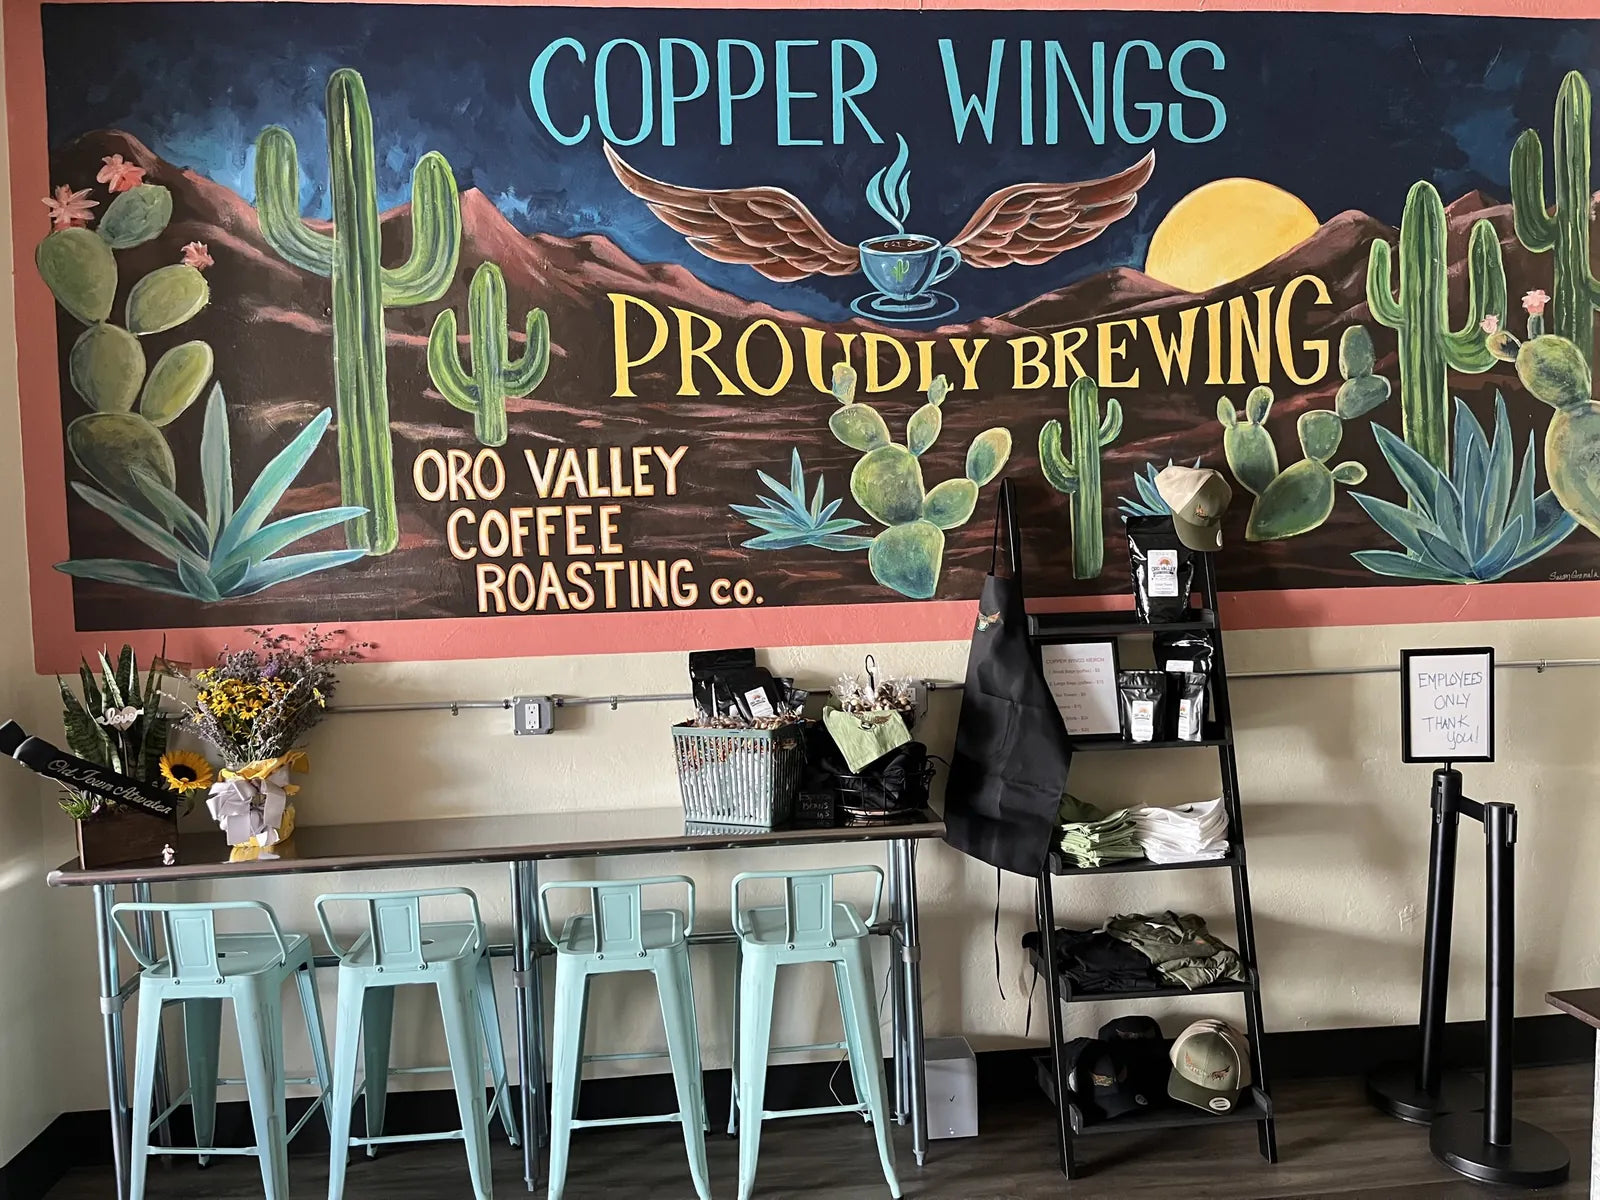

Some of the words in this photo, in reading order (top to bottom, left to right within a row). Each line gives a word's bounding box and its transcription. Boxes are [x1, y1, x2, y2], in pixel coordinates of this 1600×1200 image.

[529, 37, 883, 147] COPPER
[938, 38, 1227, 145] WINGS
[607, 293, 989, 397] PROUDLY
[1006, 274, 1333, 389] BREWING
[413, 448, 506, 502] ORO
[524, 445, 689, 498] VALLEY
[447, 505, 624, 560] COFFEE
[476, 558, 699, 613] ROASTING
[1418, 672, 1483, 690] EMPLOYEES
[1434, 693, 1471, 710] ONLY
[1422, 714, 1470, 733] THANK
[48, 760, 79, 777] Old
[73, 770, 114, 791] Town
[113, 786, 172, 814] Atwater
